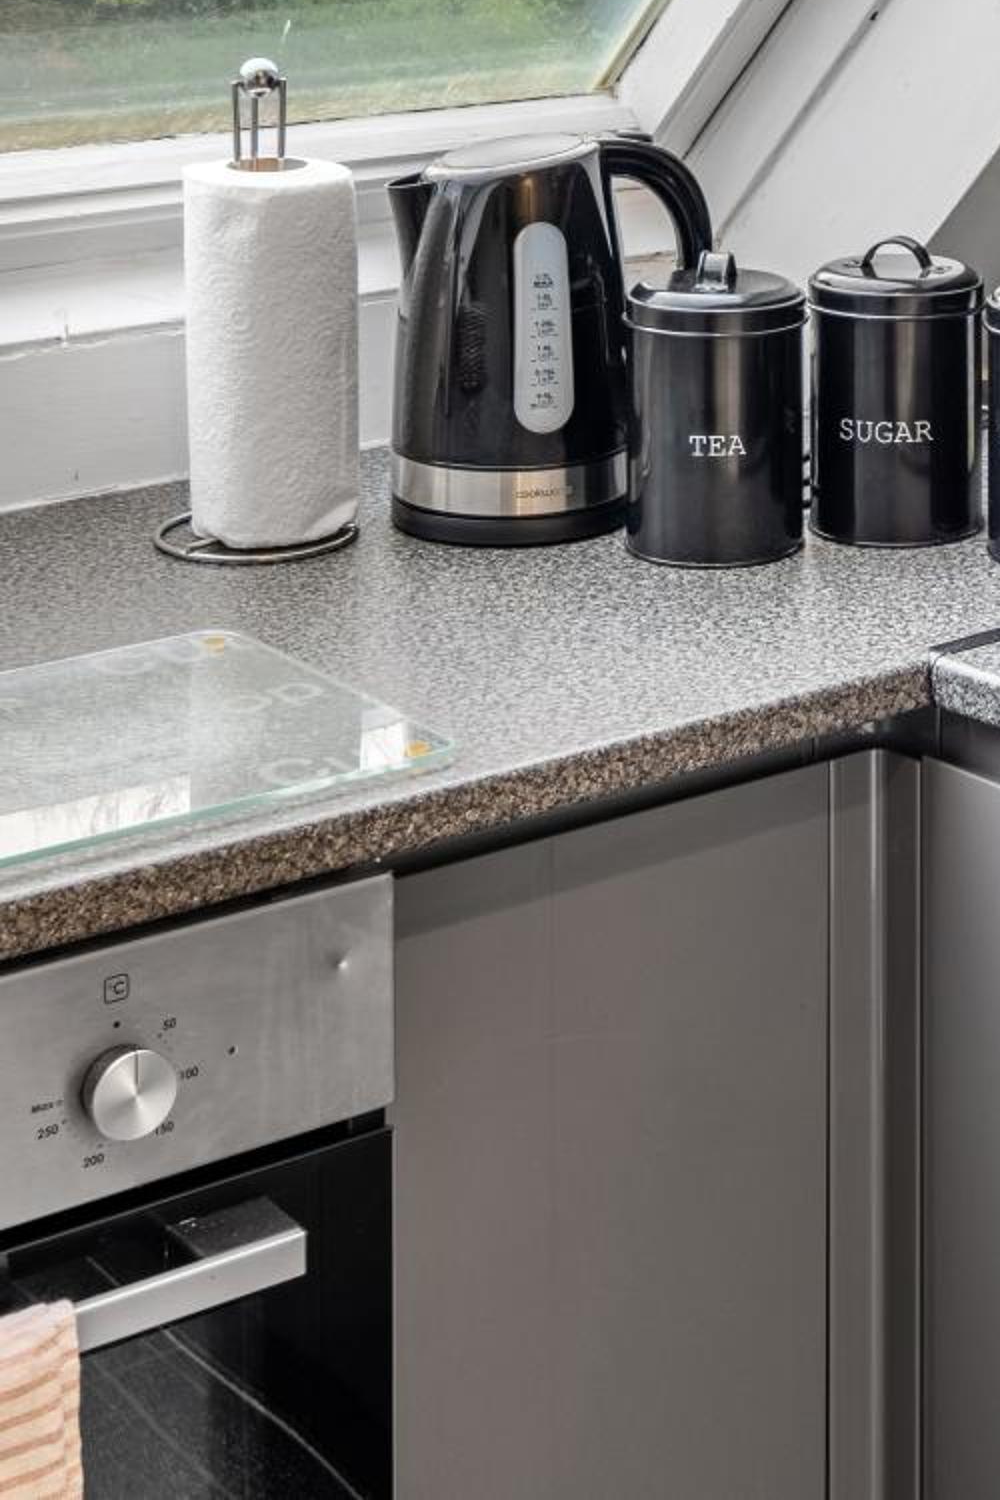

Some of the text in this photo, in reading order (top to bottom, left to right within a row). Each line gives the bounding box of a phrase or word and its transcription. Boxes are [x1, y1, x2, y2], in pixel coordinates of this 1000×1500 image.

[839, 418, 935, 444] SUGAR
[689, 435, 747, 457] TEA
[163, 1017, 177, 1031] 50
[179, 1065, 200, 1080] 100
[37, 1122, 59, 1141] 250
[82, 1153, 105, 1169] 200
